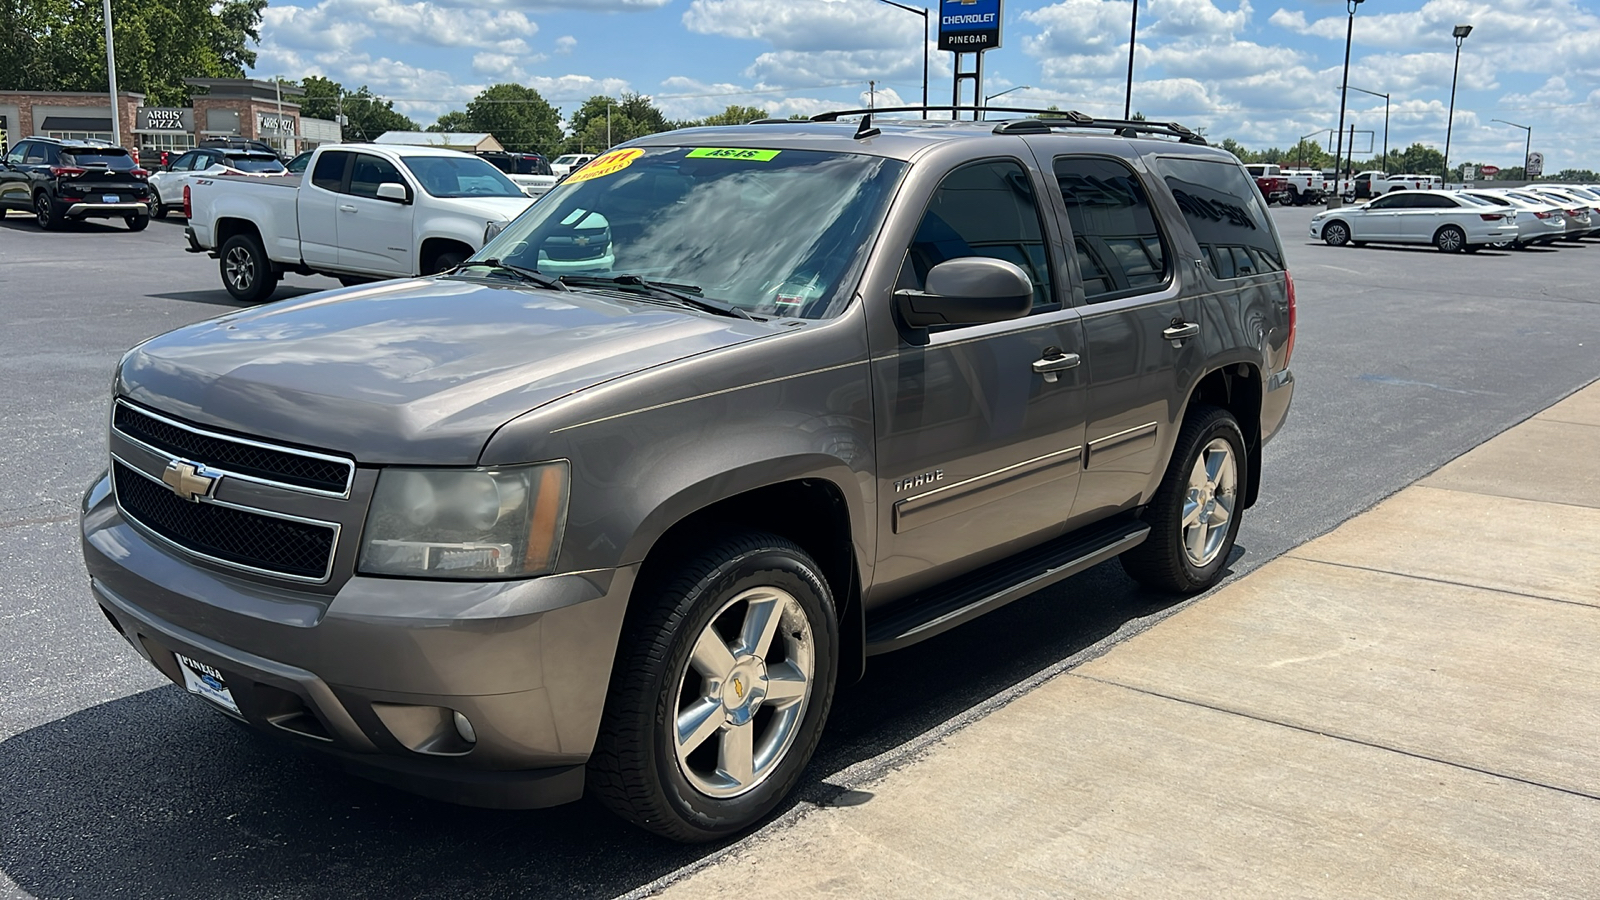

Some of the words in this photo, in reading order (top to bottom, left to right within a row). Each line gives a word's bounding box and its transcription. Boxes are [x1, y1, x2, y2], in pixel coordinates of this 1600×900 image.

[942, 13, 995, 24] CHEVROLET
[948, 34, 988, 44] PINEGAR
[146, 110, 183, 120] ARRIS'
[148, 119, 183, 128] PIZZA
[893, 469, 944, 493] TAHOE
